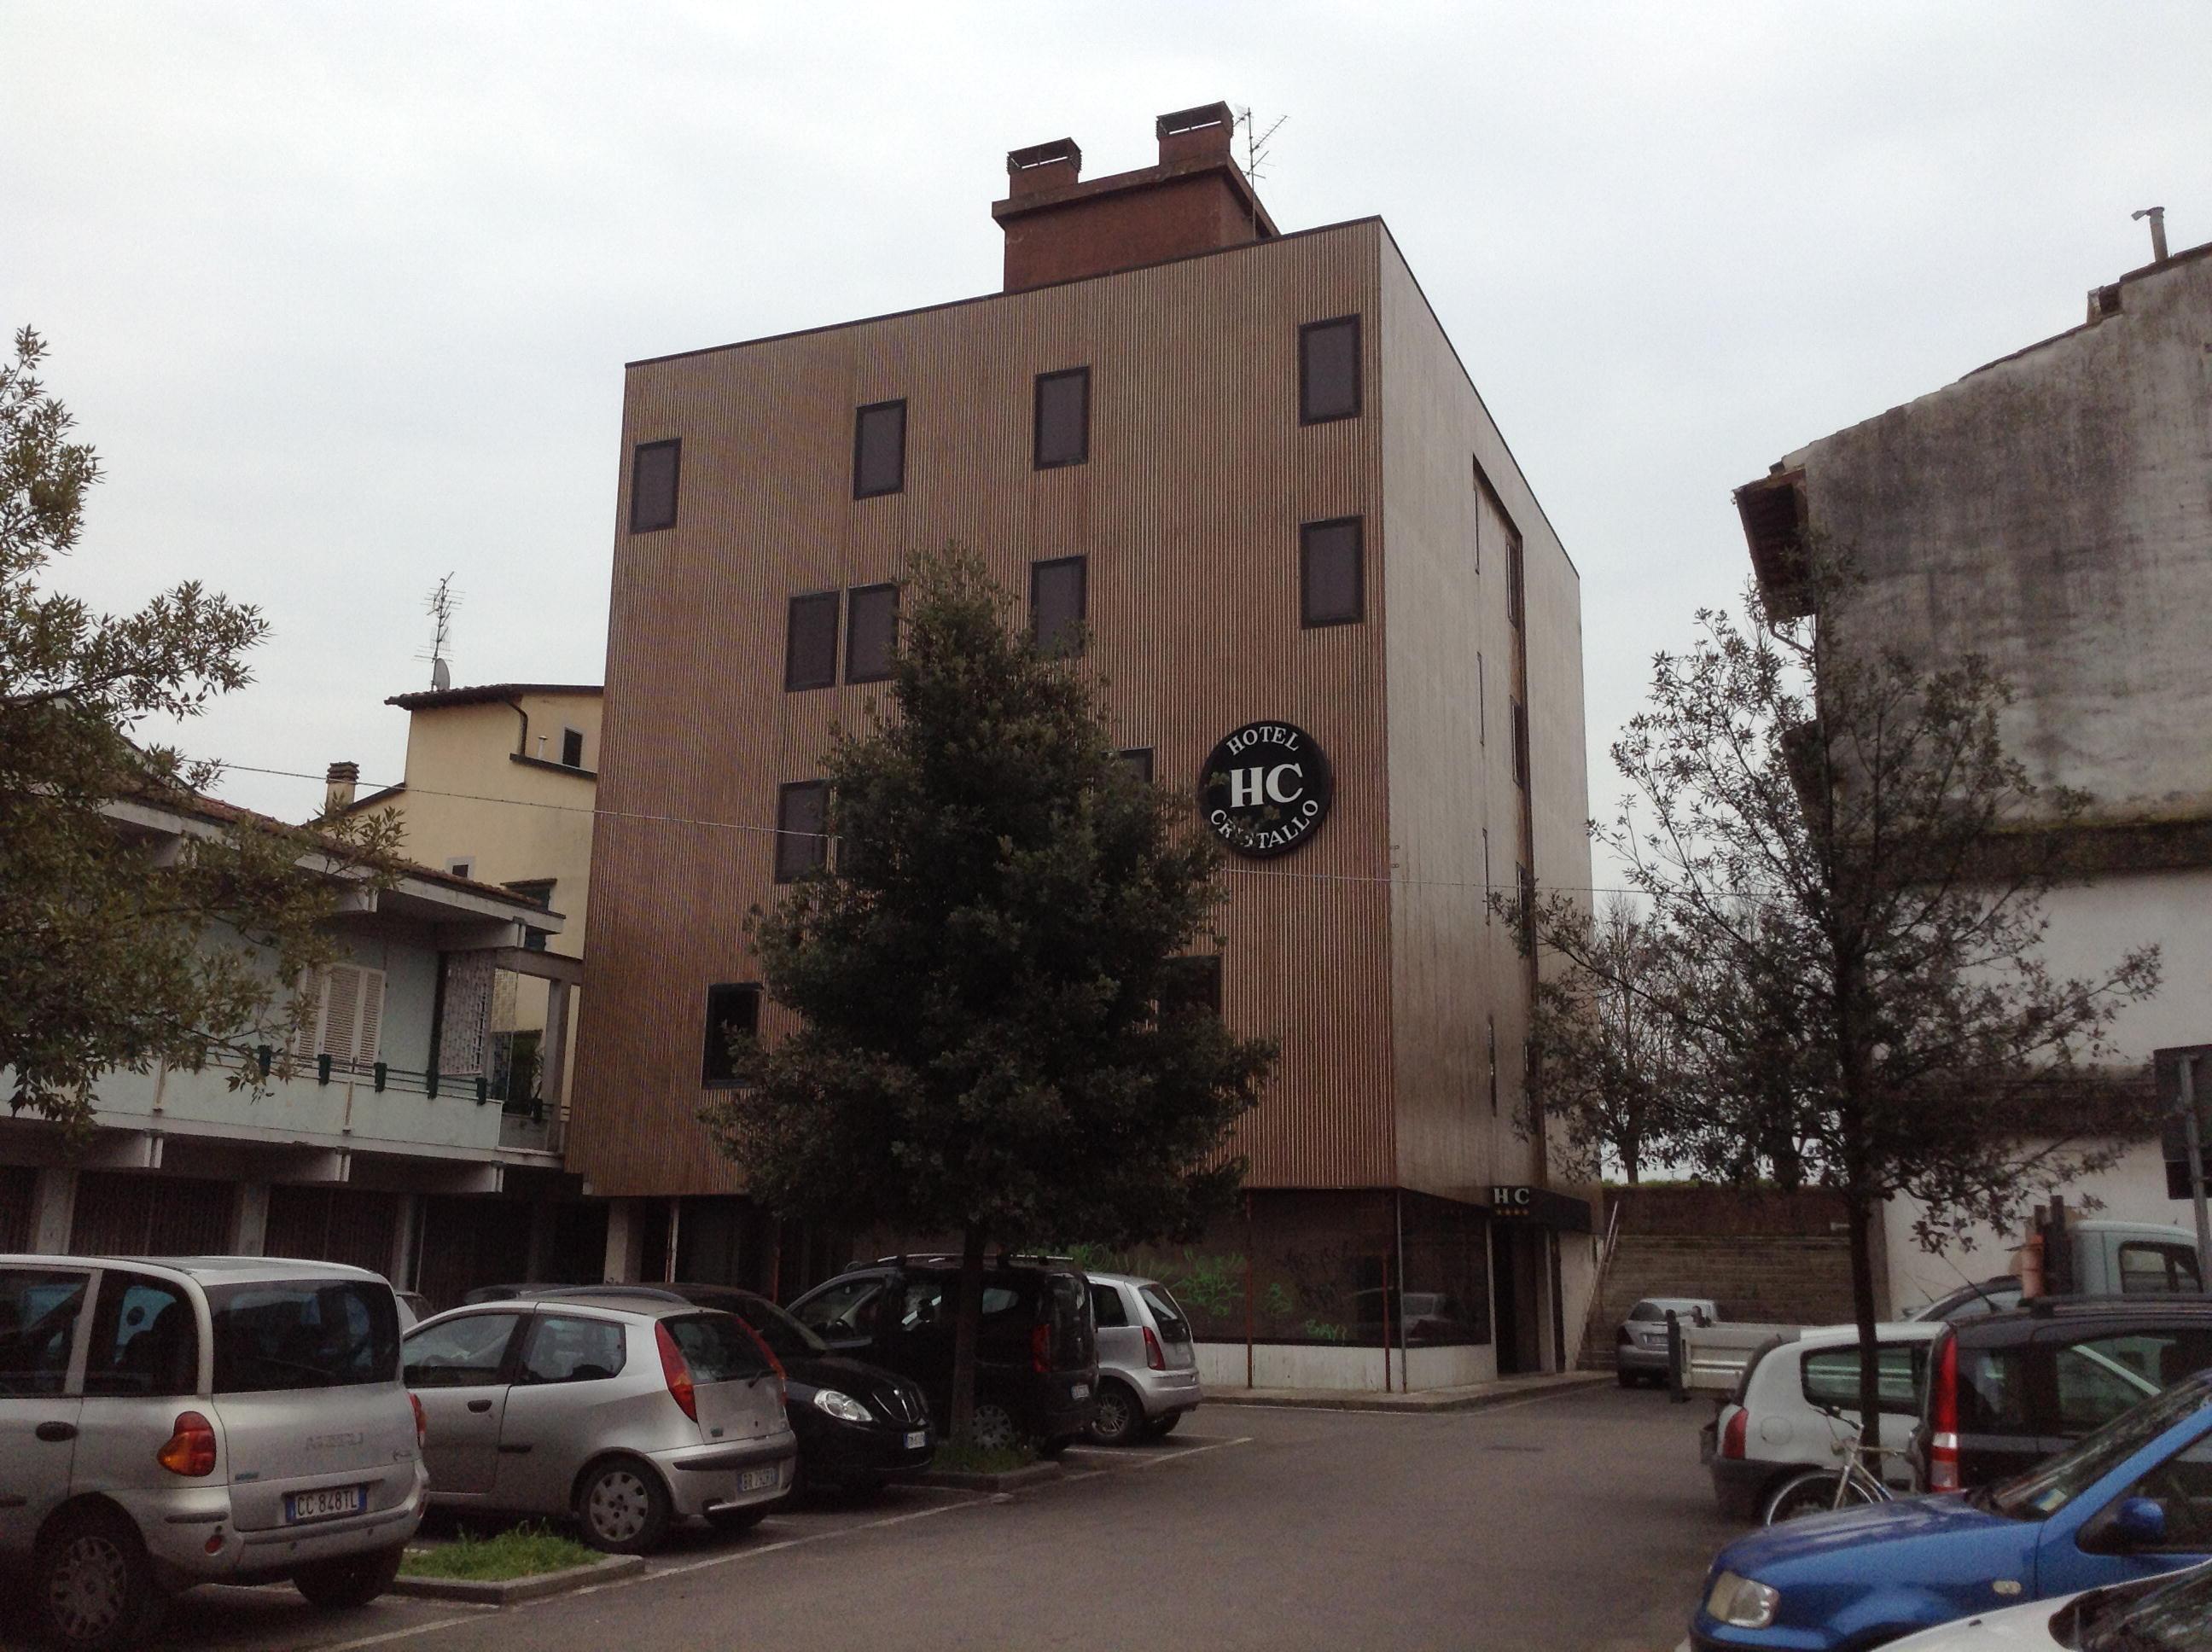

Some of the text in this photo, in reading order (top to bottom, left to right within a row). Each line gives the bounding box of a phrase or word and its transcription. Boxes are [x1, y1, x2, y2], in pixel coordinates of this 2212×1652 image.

[1225, 725, 1300, 756] HOTEL
[1229, 762, 1304, 808] HC
[1210, 800, 1318, 849] CRTALLO
[1493, 1188, 1530, 1204] HC
